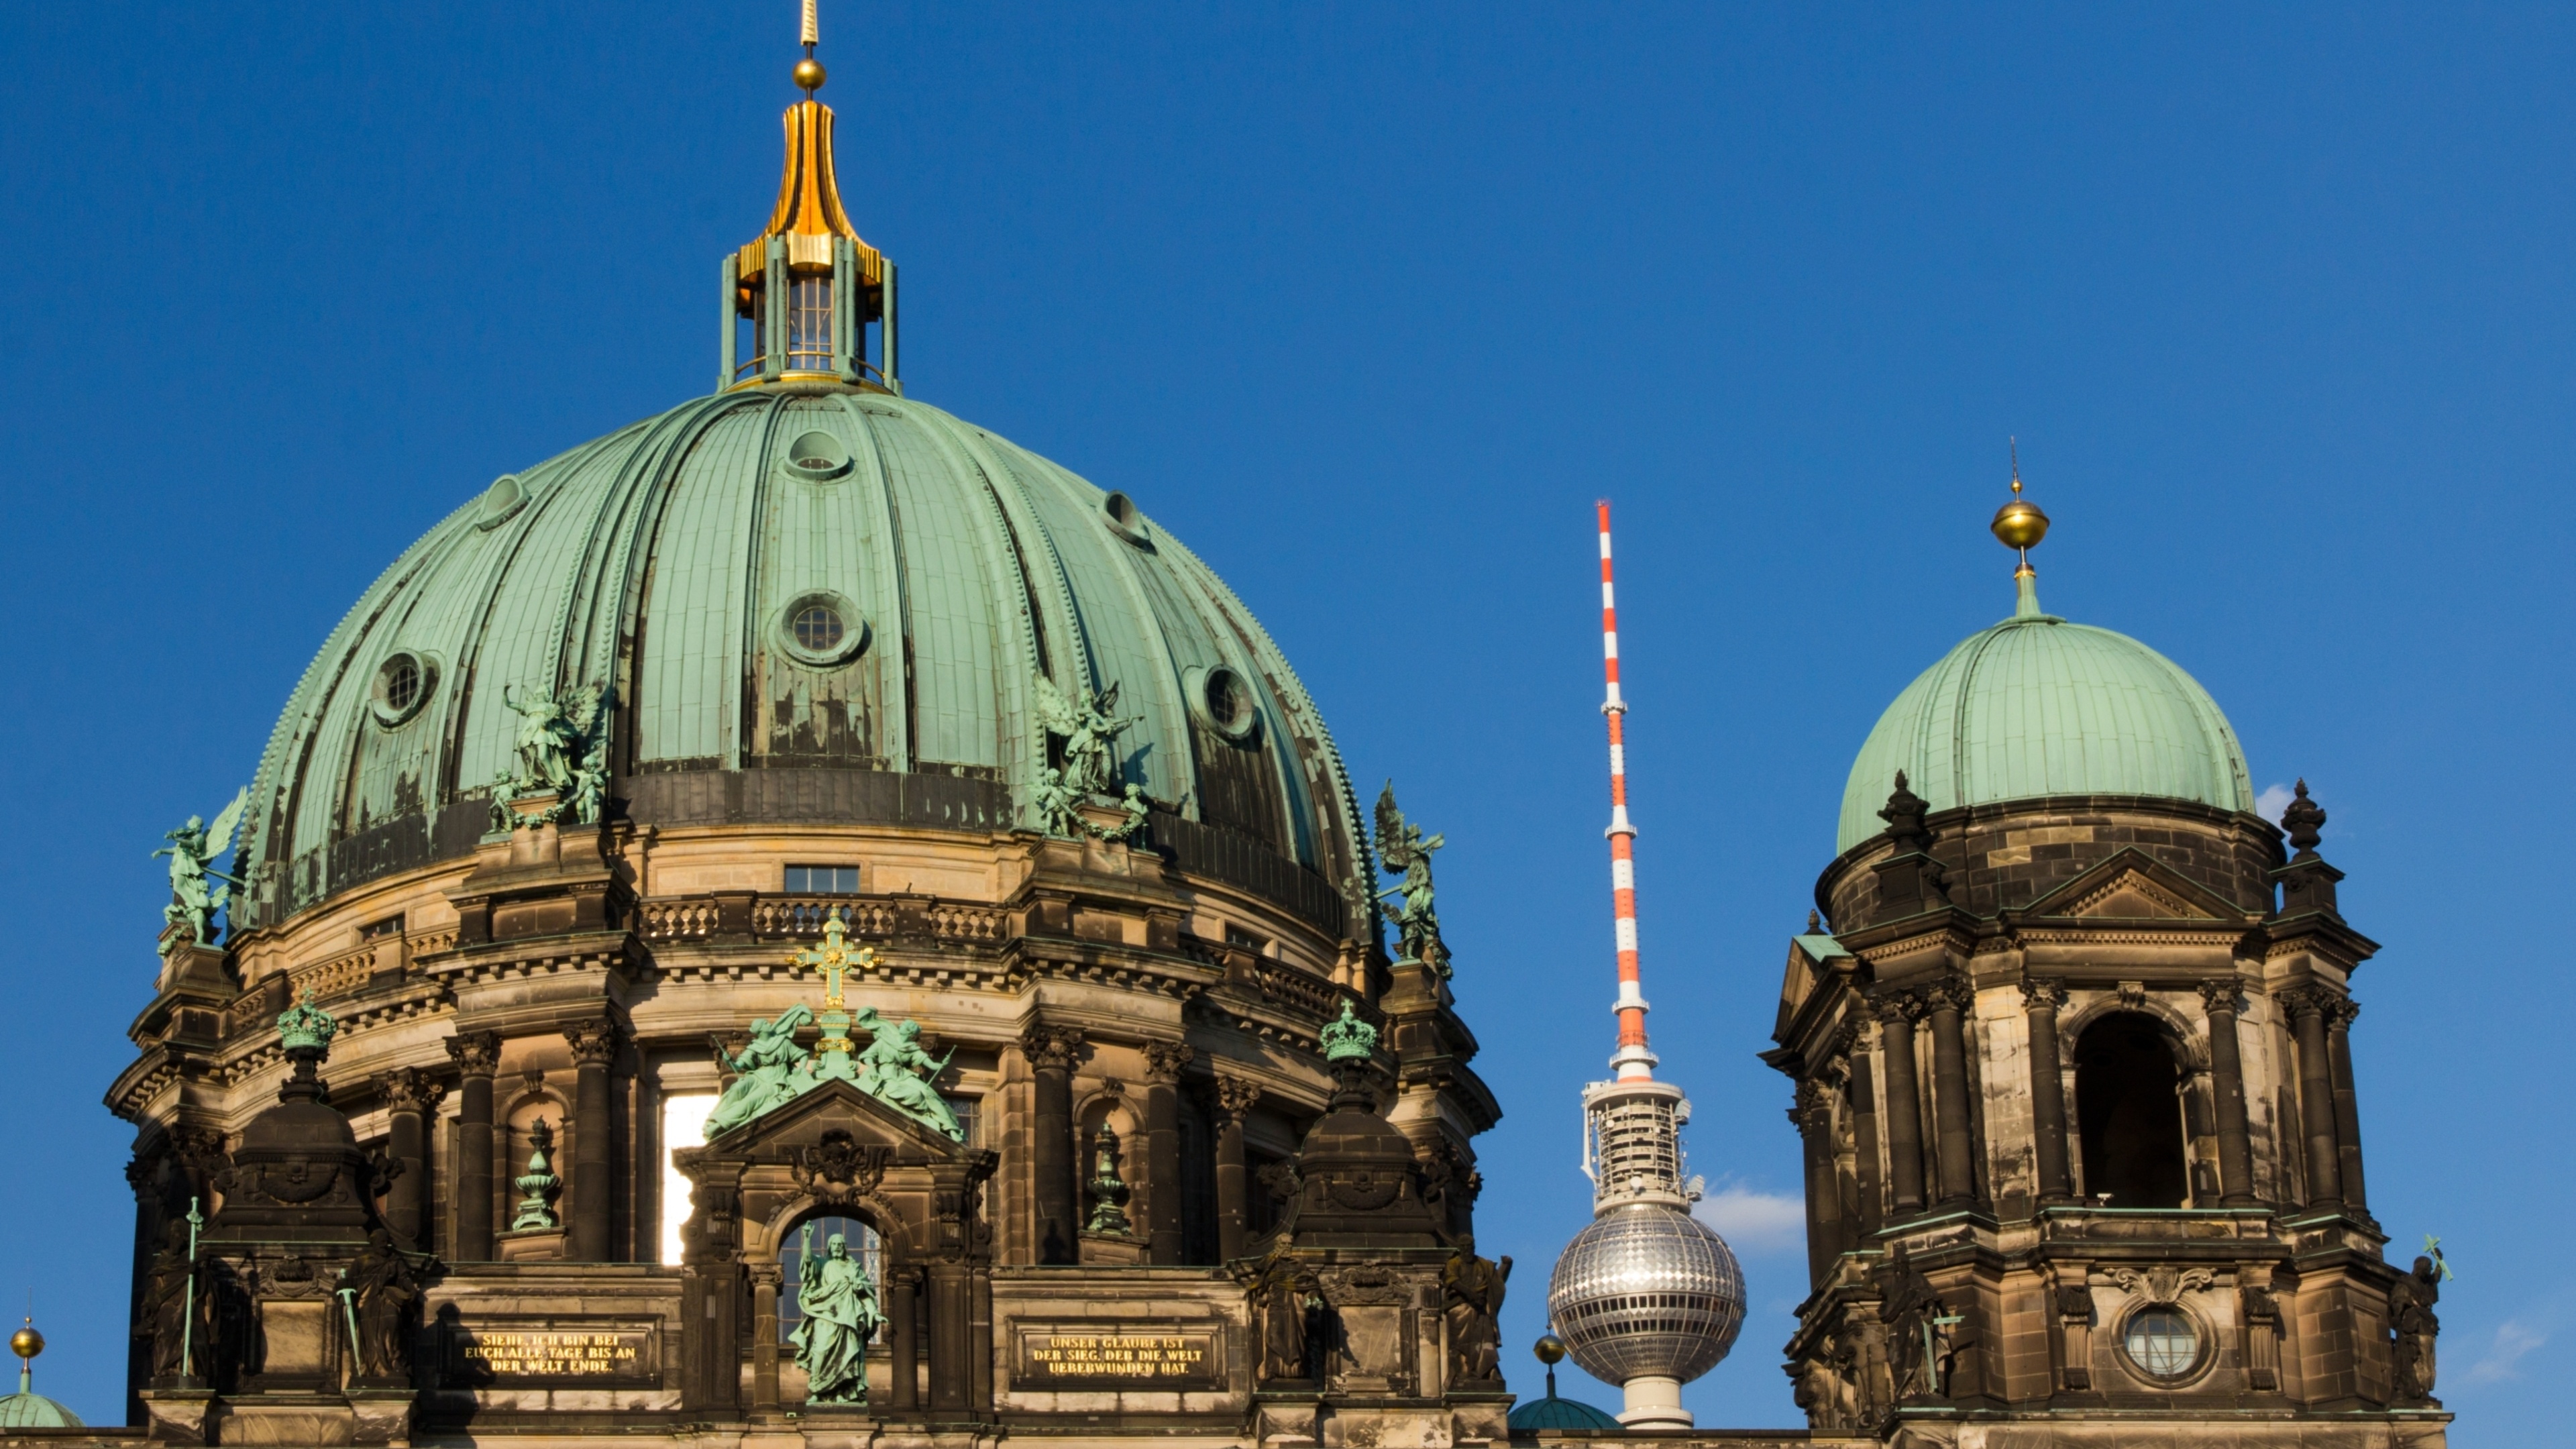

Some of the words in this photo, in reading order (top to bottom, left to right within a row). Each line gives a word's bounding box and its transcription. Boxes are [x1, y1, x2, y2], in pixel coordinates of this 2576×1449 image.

[533, 1335, 557, 1345] ICH
[564, 1335, 589, 1345] BIN
[594, 1335, 618, 1345] BEI
[1051, 1338, 1097, 1348] UNSER
[1102, 1338, 1158, 1348] GLAUBE
[1163, 1338, 1185, 1348] IST
[465, 1347, 503, 1358] EUCH
[508, 1347, 543, 1358] ALLE
[547, 1347, 583, 1358] TAGE
[588, 1347, 611, 1358] BIS
[615, 1347, 635, 1358] AN
[1034, 1350, 1061, 1360] DER
[1105, 1350, 1133, 1360] DER
[1138, 1350, 1162, 1360] DIE
[1167, 1350, 1202, 1361] WELT
[492, 1360, 521, 1371] DER
[526, 1360, 564, 1371] WELT
[570, 1360, 612, 1371] ENDE.
[1049, 1362, 1155, 1373] UEBERWUNDEN
[1161, 1362, 1189, 1373] HAT.
